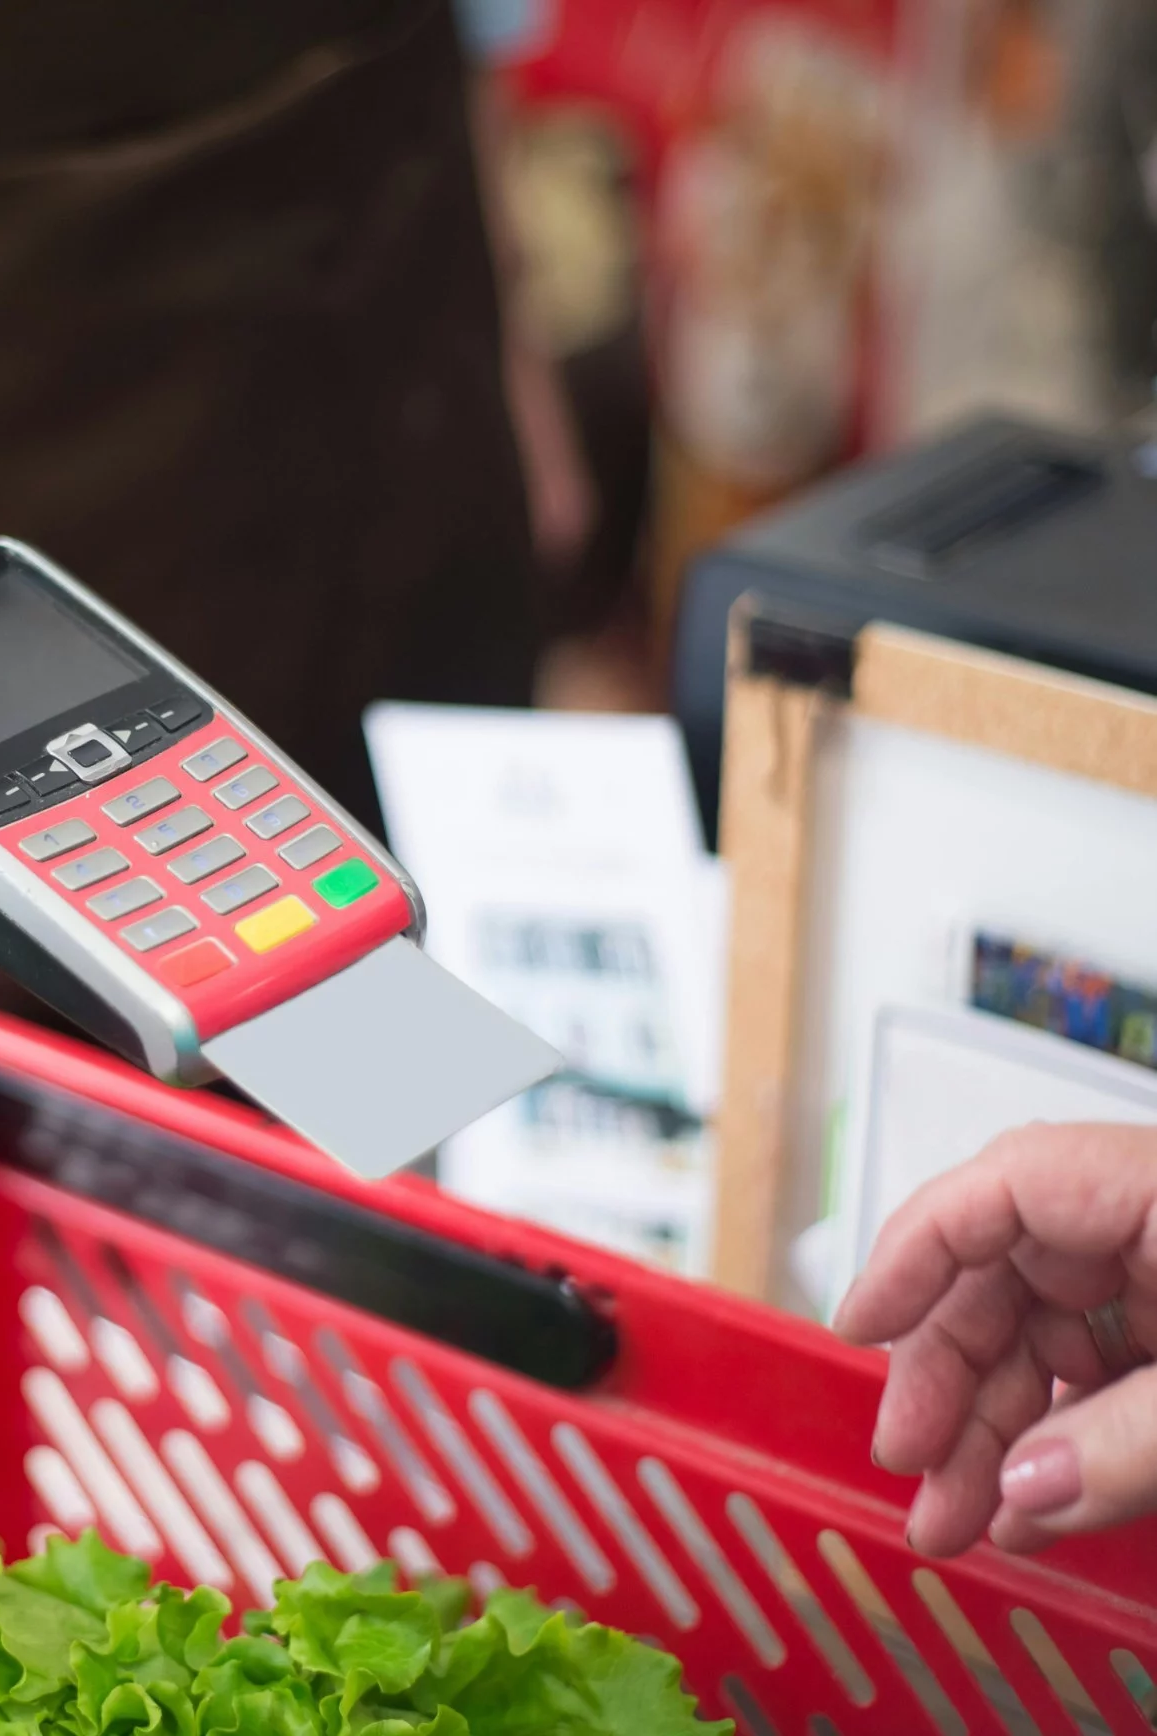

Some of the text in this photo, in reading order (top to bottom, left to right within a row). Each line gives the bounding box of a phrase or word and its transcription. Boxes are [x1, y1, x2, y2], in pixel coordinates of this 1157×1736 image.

[43, 754, 219, 846] 1 2 3
[157, 823, 177, 838] 5
[231, 783, 249, 798] 6
[105, 893, 122, 907] 7
[263, 812, 281, 827] 9
